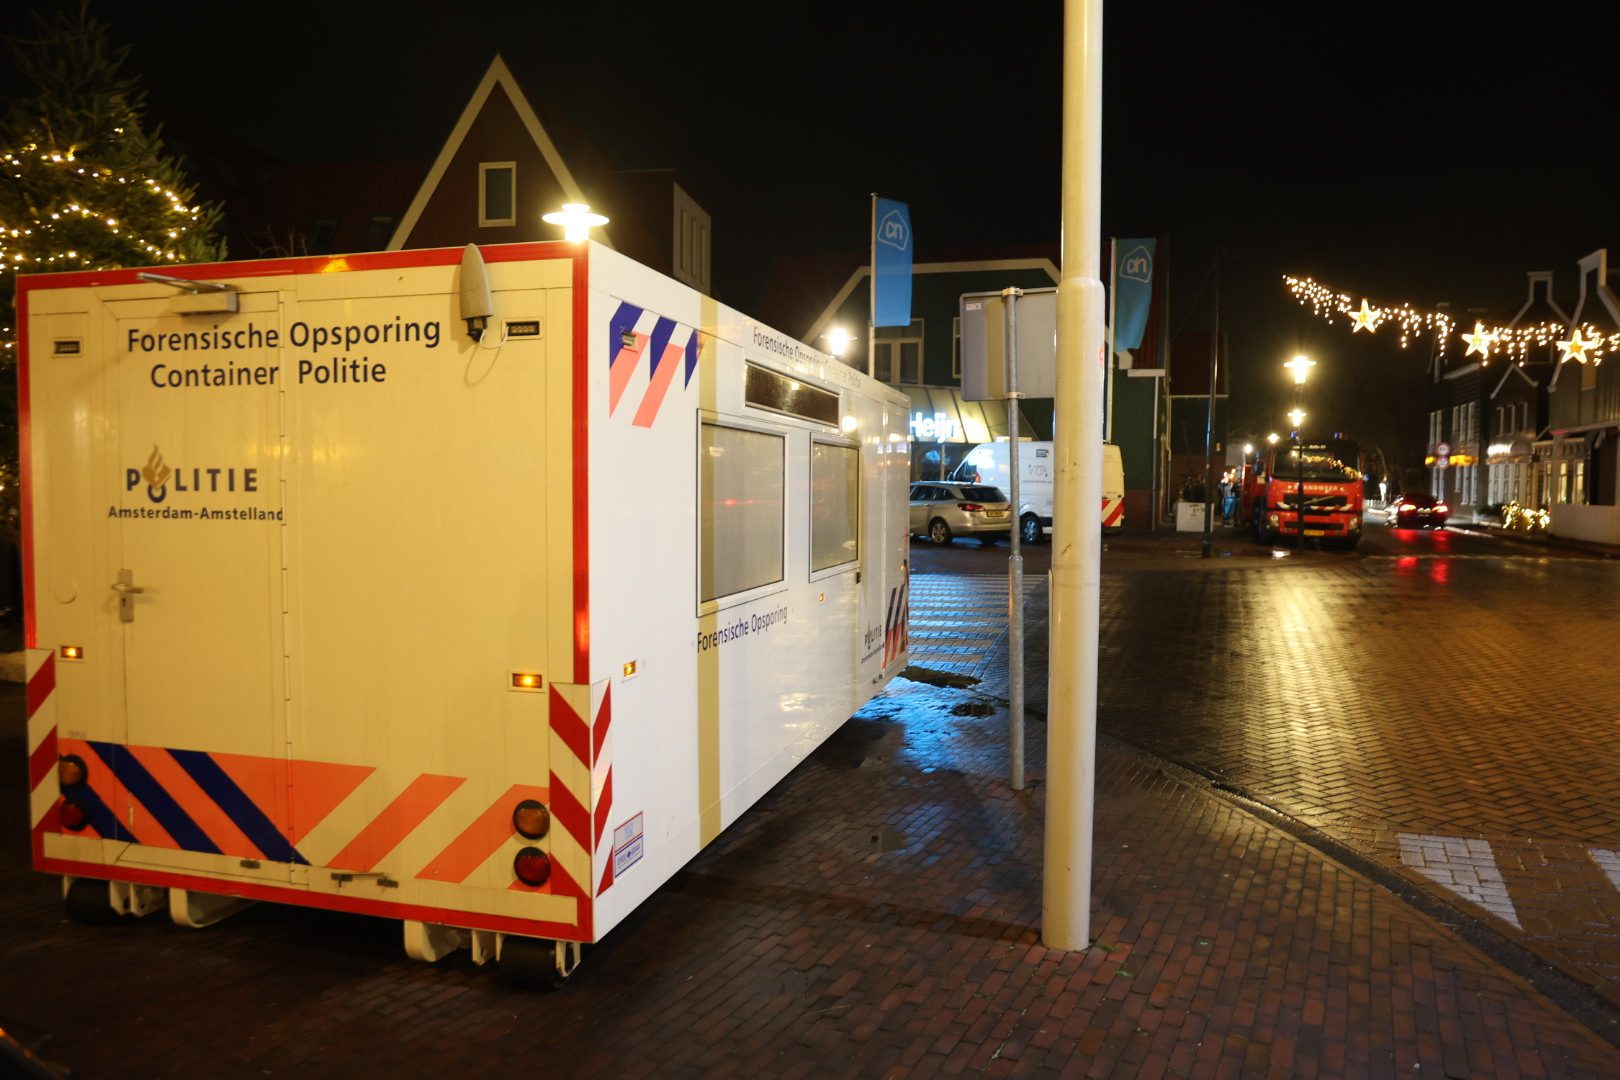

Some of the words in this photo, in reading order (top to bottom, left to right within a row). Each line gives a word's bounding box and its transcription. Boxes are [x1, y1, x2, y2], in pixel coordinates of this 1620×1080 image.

[128, 323, 279, 352] Forensische
[290, 316, 440, 352] Opsporing
[753, 326, 794, 360] Forensische
[151, 361, 279, 388] Container
[298, 357, 386, 384] Politie
[126, 468, 258, 503] POLITIE
[108, 506, 284, 520] Amsterdam-Amstelland
[697, 617, 749, 653] Forensische
[751, 605, 788, 635] Opsporing
